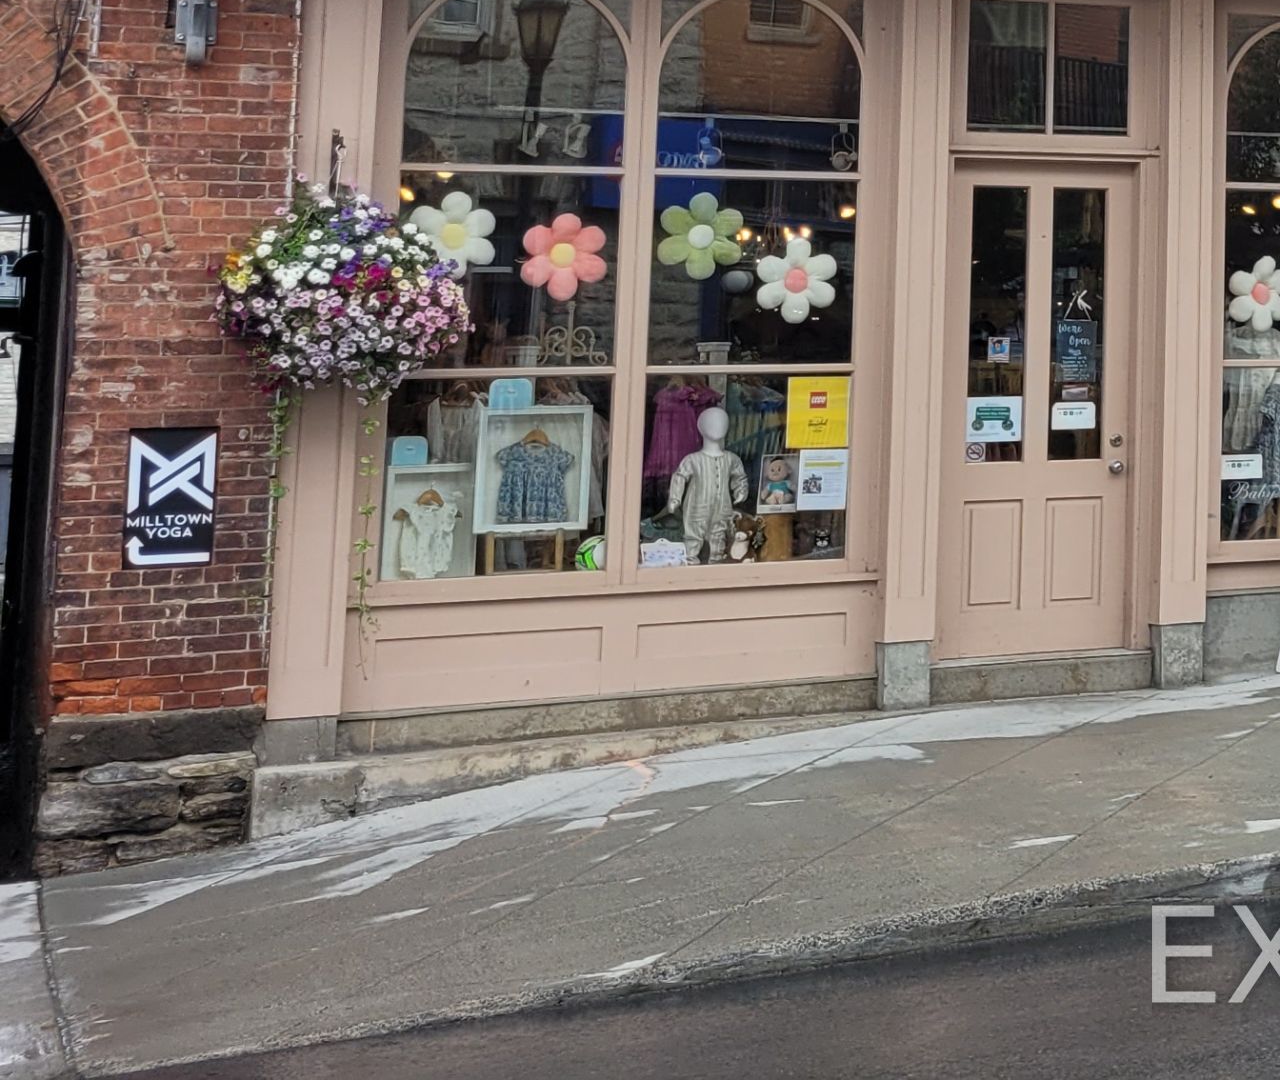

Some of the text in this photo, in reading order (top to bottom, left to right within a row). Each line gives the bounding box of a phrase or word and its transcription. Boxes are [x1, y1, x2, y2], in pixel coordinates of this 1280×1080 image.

[1228, 481, 1280, 504] Baby
[126, 513, 213, 528] MILLTOWN
[146, 526, 193, 539] YOGA
